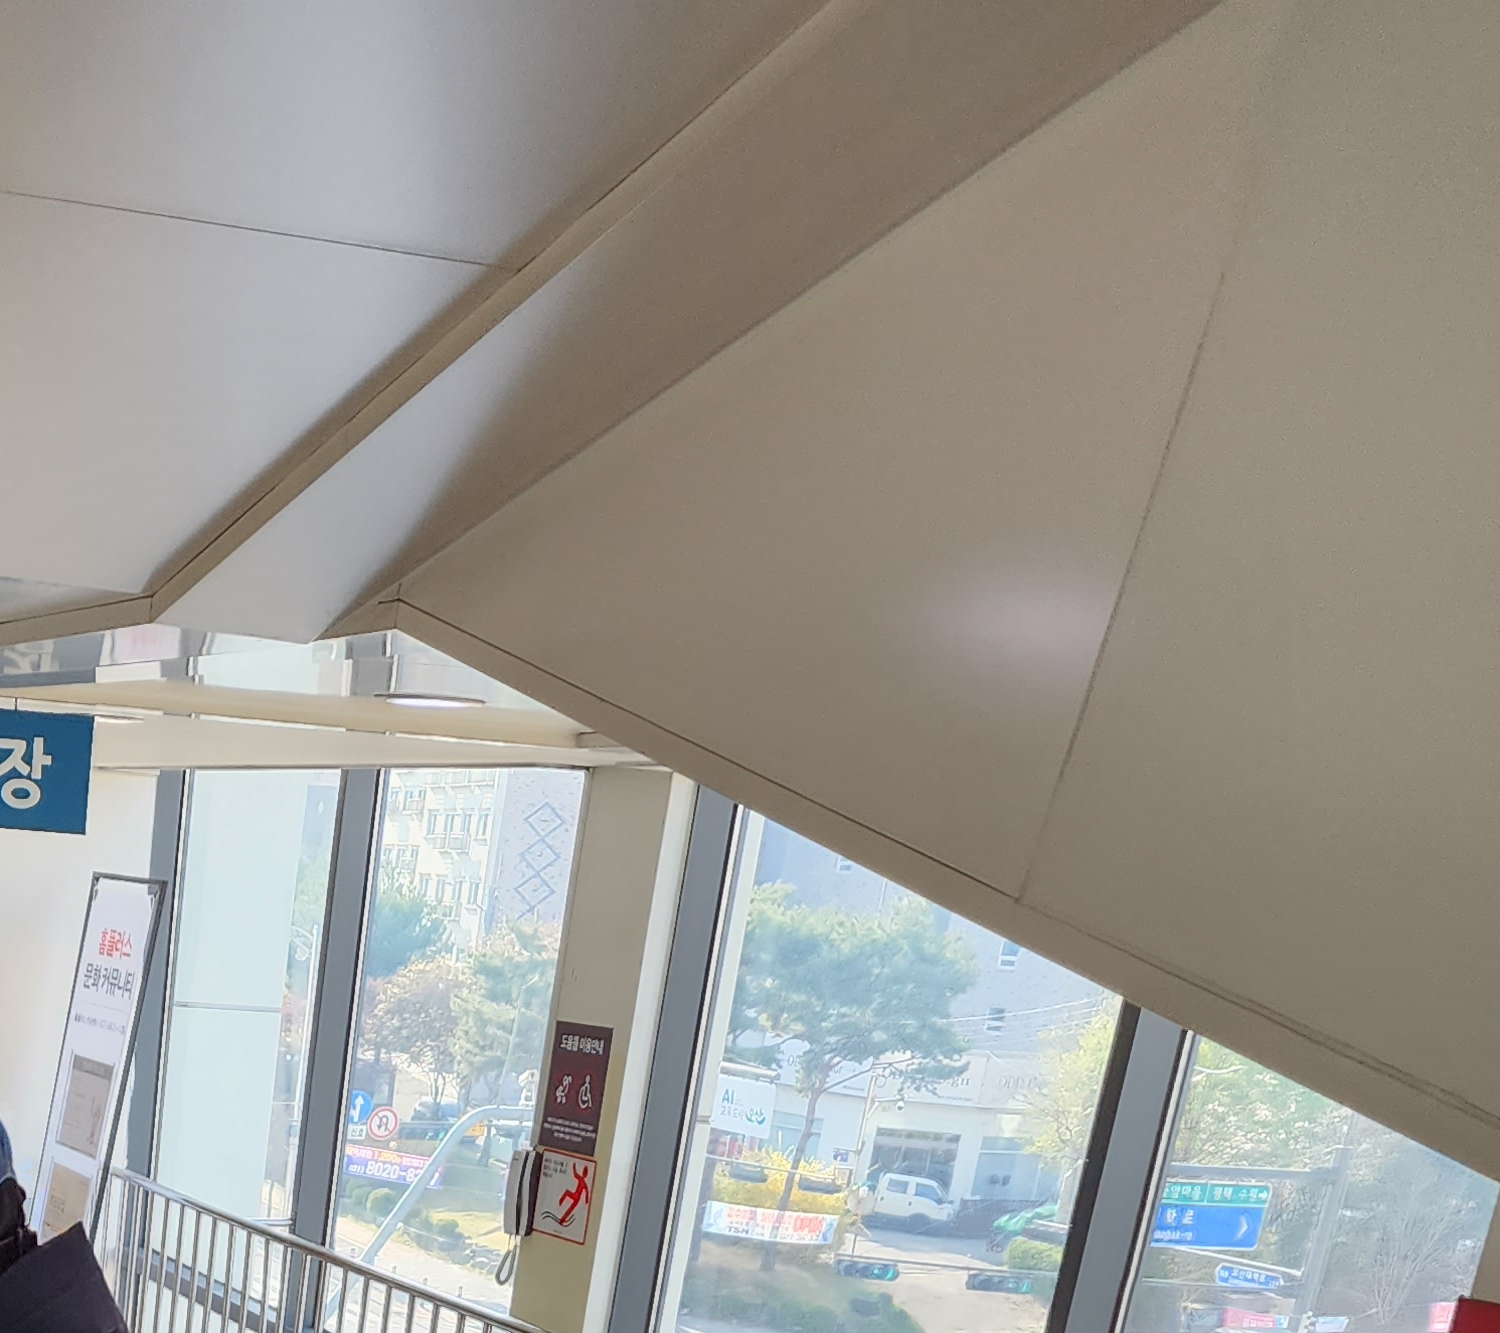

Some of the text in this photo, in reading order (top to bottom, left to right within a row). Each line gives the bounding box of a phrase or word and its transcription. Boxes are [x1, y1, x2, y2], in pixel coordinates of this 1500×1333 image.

[98, 927, 132, 961] 홈플러스
[83, 963, 136, 1001] 문화 커뮤니티
[721, 1088, 735, 1105] AI
